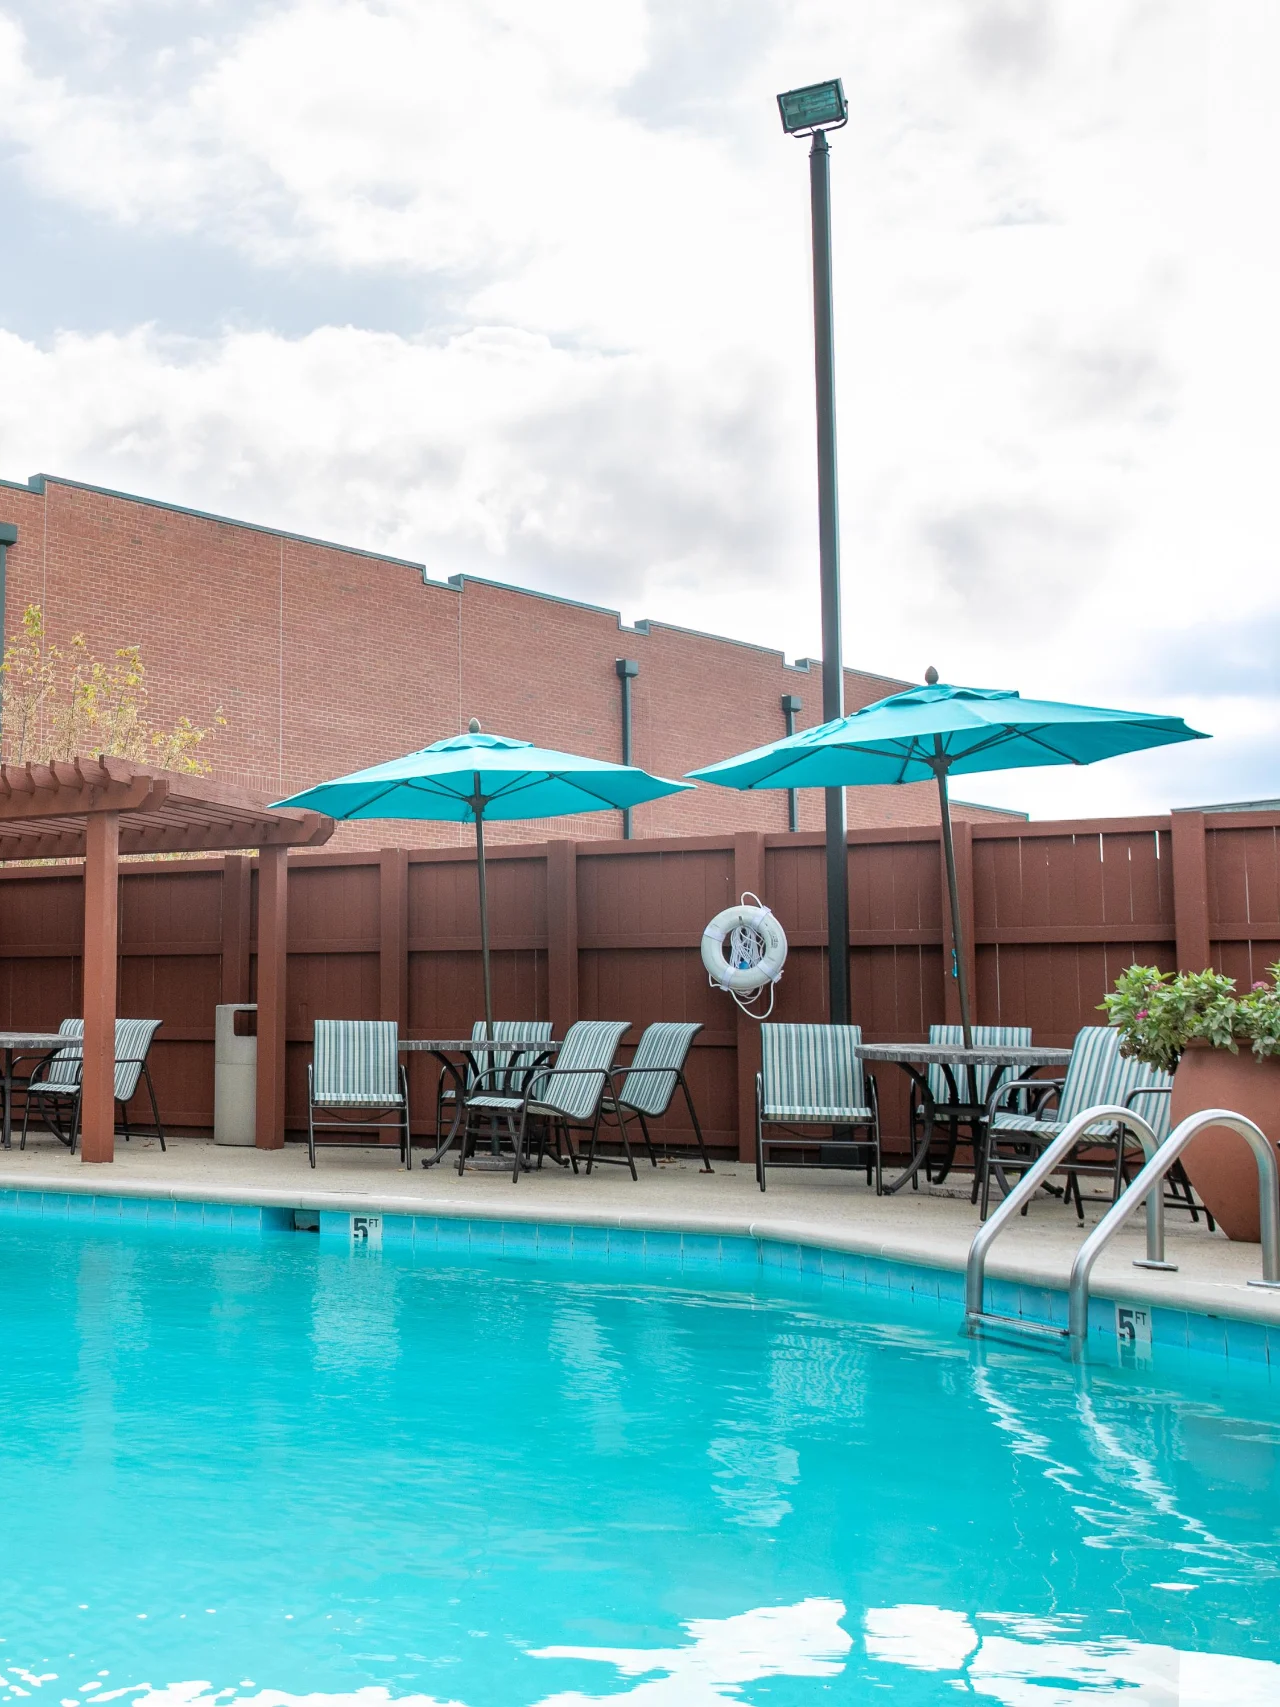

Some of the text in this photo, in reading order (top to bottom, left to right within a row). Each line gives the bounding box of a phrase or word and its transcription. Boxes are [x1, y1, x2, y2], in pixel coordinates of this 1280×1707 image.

[353, 1217, 379, 1240] 5 FT
[1118, 1308, 1146, 1342] 5 FT
